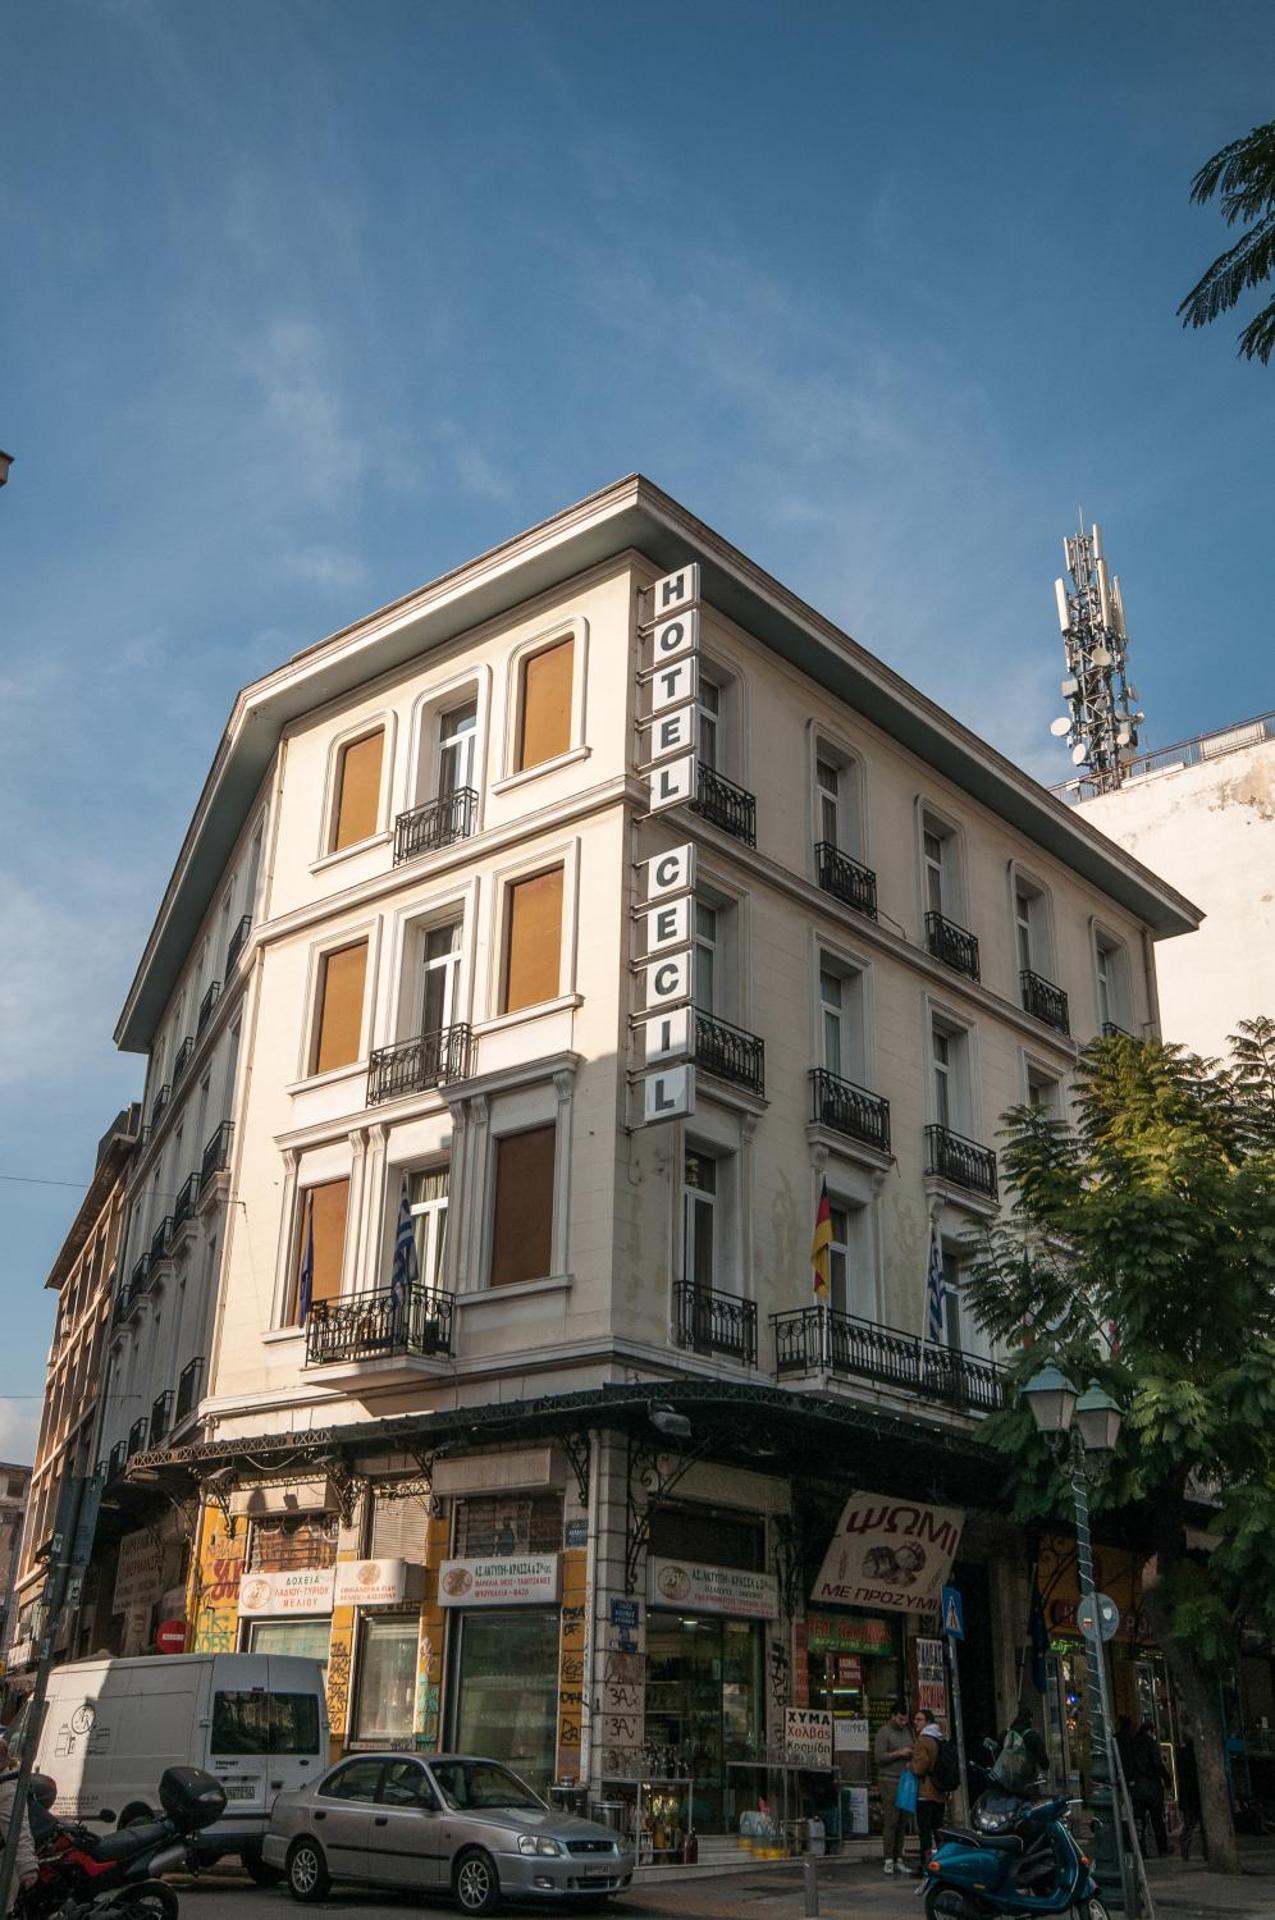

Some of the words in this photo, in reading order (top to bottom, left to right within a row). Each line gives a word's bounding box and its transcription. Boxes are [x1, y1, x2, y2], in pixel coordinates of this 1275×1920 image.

[660, 573, 684, 800] HOTEL
[654, 856, 680, 1112] CECIL
[846, 1506, 959, 1557] ΨΩΜΙ
[286, 1575, 320, 1586] ΔΟΧΕΙΑ
[821, 1583, 852, 1598] ΜΕ
[855, 1588, 937, 1610] ΠΡΟΖΥΜΙ
[788, 1711, 830, 1725] ΧΥΜΑ
